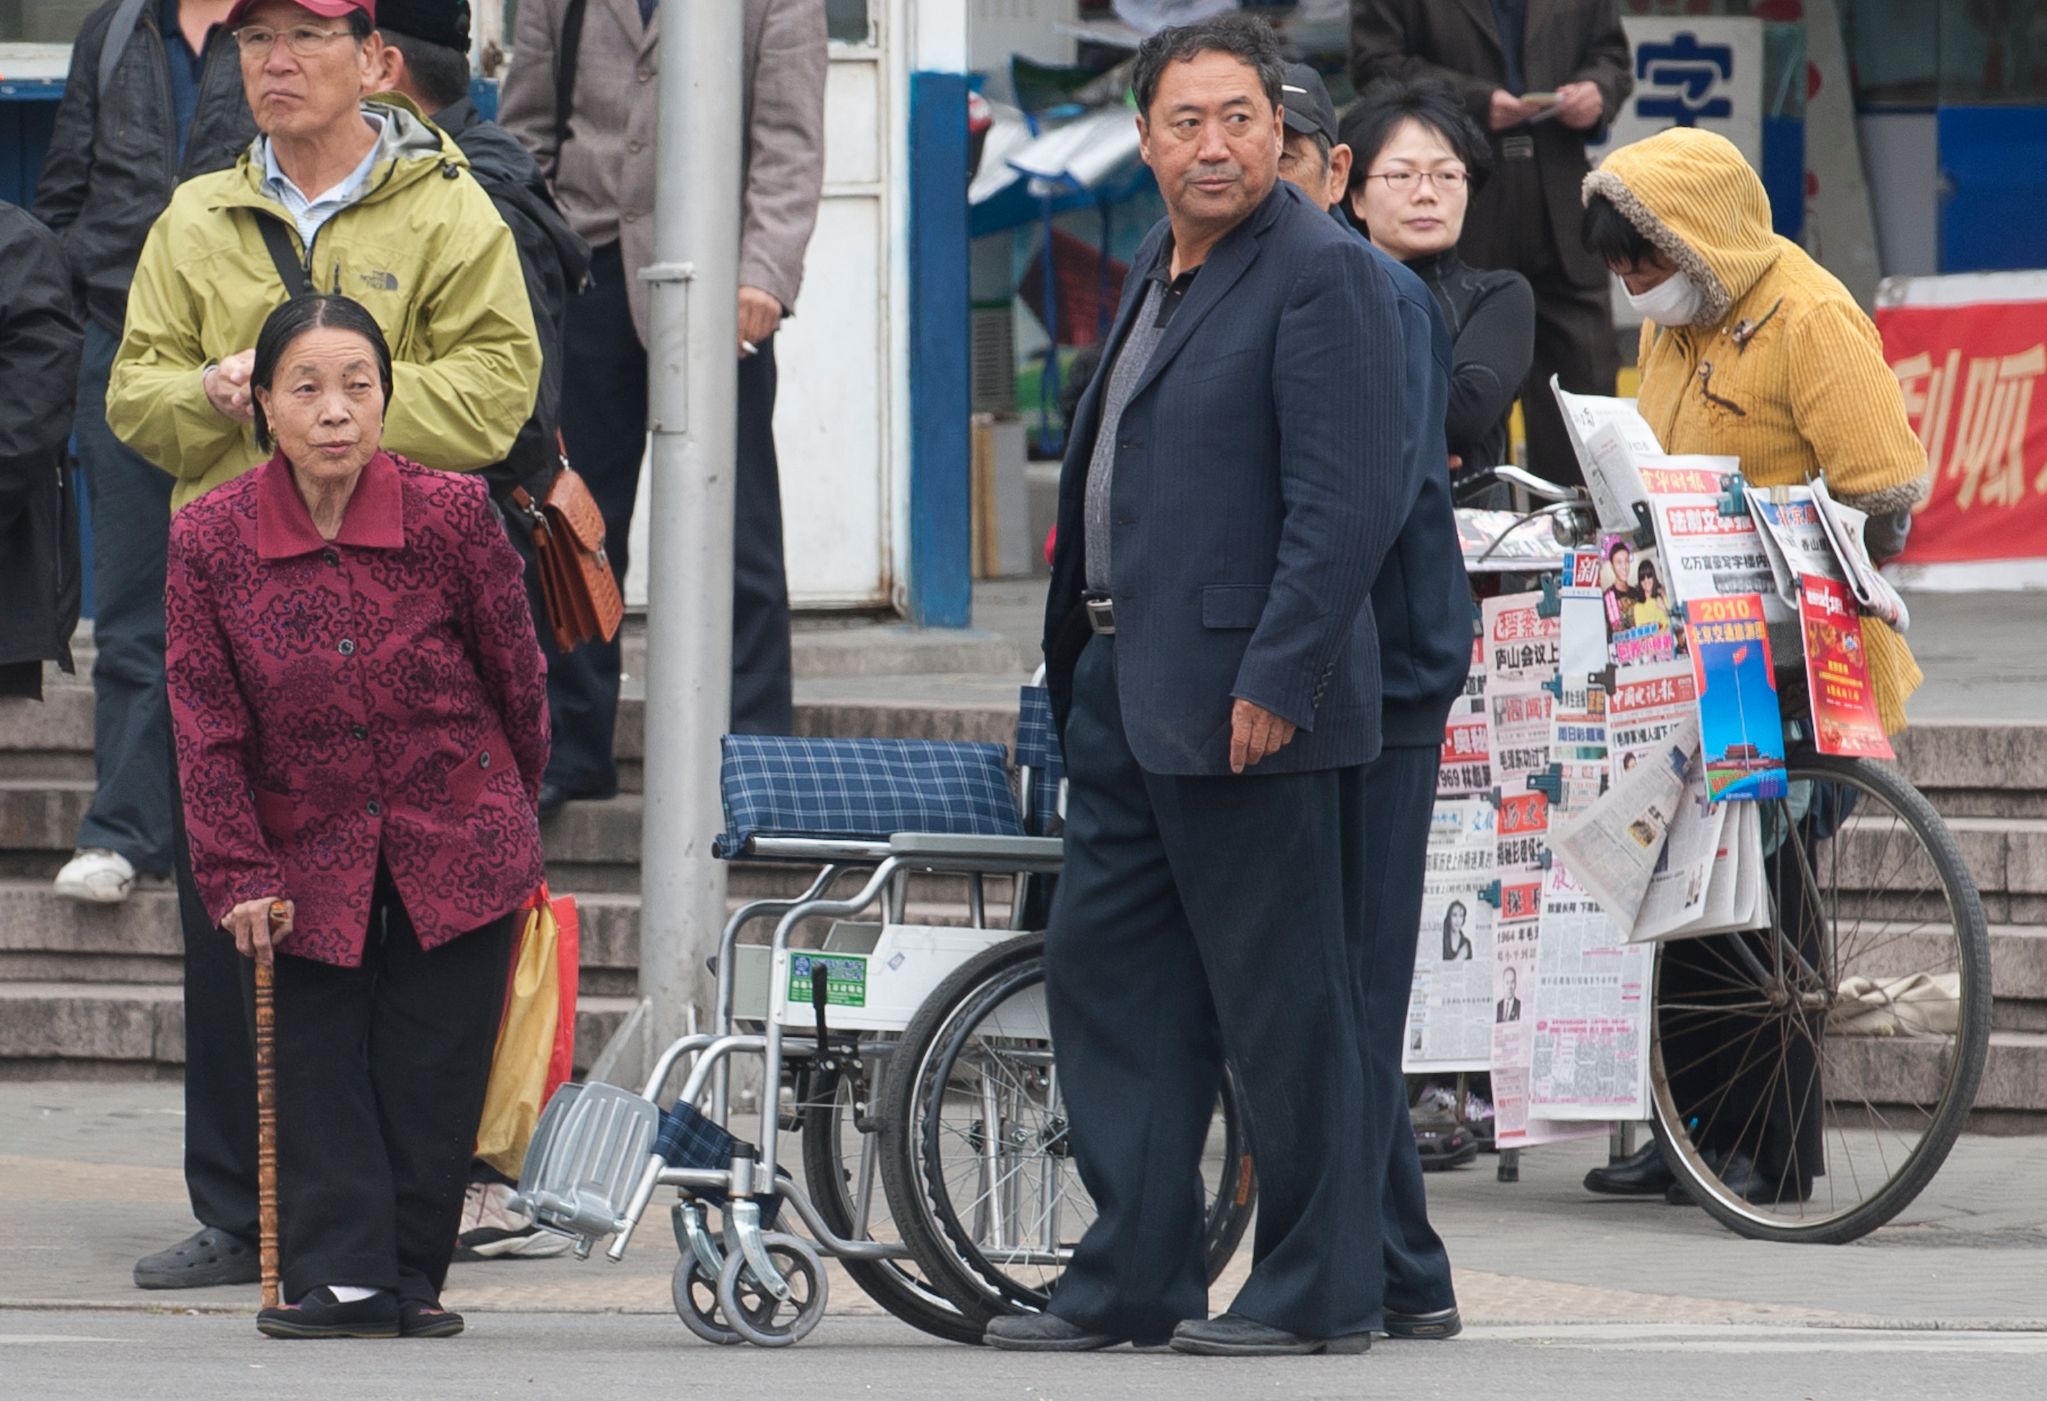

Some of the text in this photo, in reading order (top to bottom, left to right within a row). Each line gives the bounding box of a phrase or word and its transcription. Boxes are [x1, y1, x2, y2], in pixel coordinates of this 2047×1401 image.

[1700, 599, 1750, 621] 2010
[1495, 641, 1559, 671] 庐山会议上
